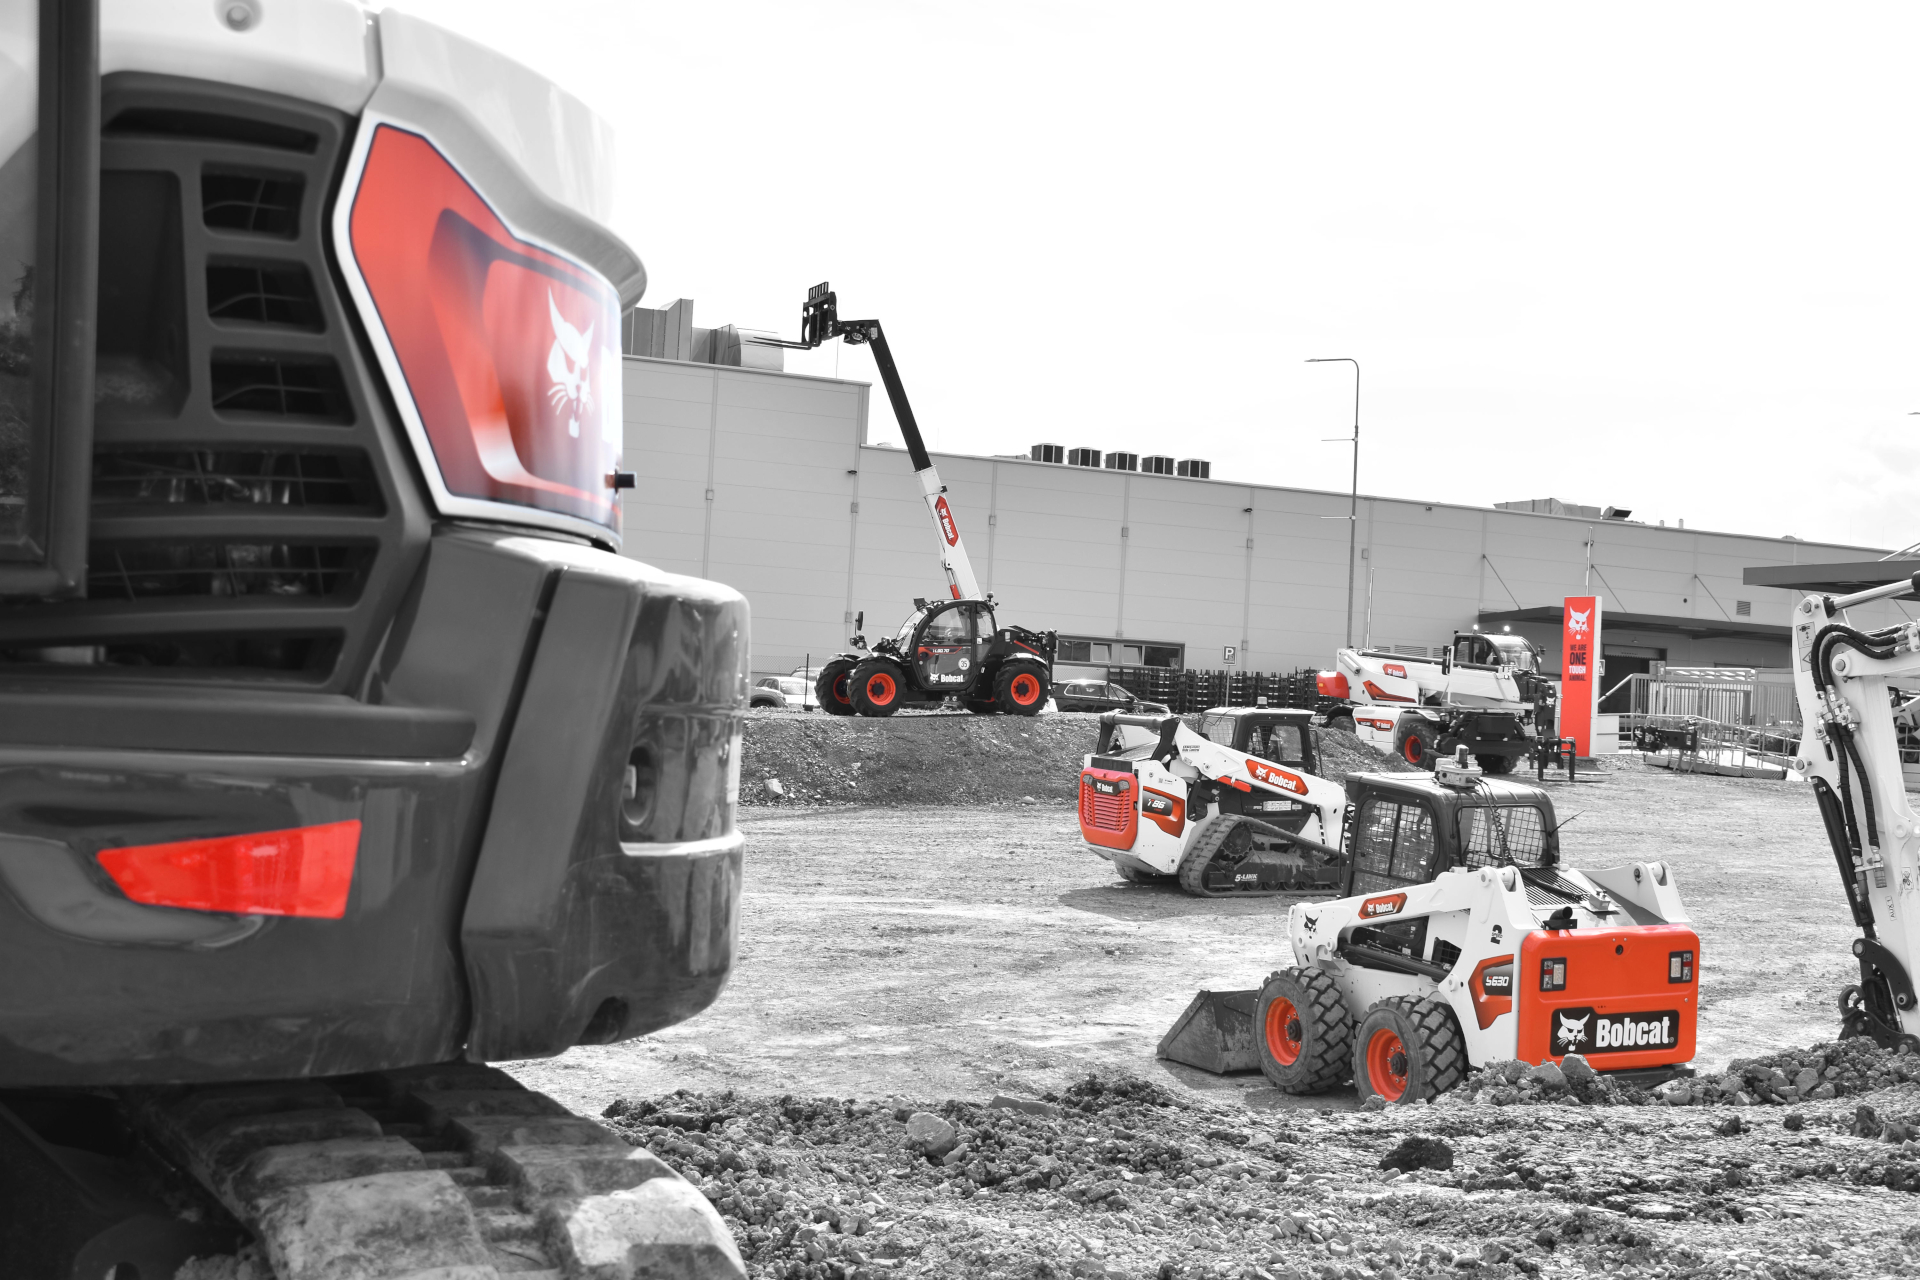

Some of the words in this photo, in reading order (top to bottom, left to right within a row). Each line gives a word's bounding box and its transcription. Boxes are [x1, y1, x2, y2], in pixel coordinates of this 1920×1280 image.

[942, 518, 954, 540] Bobcat
[1225, 647, 1234, 660] P
[1569, 652, 1586, 665] ONE
[961, 660, 968, 668] 35
[1569, 665, 1586, 674] TOUGH
[941, 674, 964, 683] Bobcat
[1268, 772, 1297, 791] Bobcat
[1147, 798, 1166, 809] T86
[1375, 902, 1394, 914] Bobcat
[1485, 976, 1510, 987] S630
[1596, 1016, 1670, 1048] Bobcat
